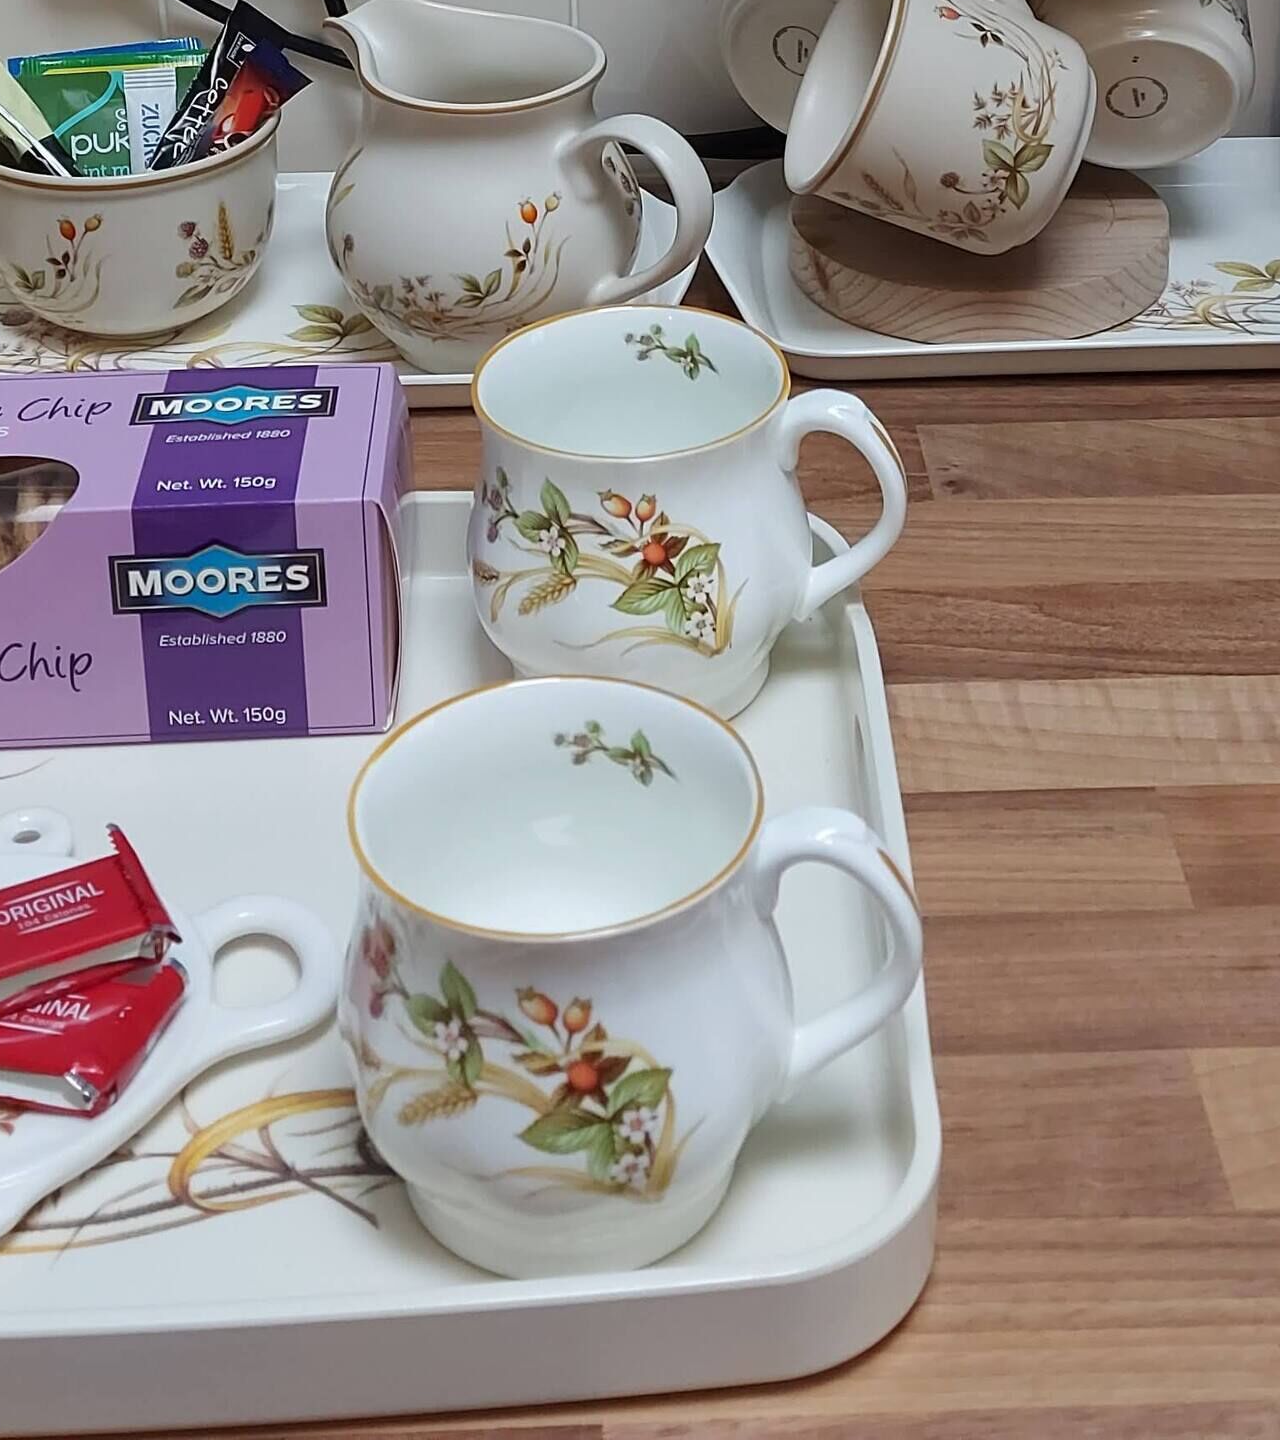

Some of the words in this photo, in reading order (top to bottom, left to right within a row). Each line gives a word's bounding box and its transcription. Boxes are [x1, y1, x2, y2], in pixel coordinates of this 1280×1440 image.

[70, 131, 131, 162] puk
[16, 396, 112, 425] Chip
[148, 393, 324, 417] MOORES
[165, 431, 252, 444] Established
[256, 429, 291, 439] 1880
[156, 479, 193, 491] Net.
[199, 478, 228, 490] Wt.
[233, 476, 277, 490] 150g
[127, 564, 311, 598] MOORES
[158, 632, 247, 647] Established
[251, 630, 287, 644] 1880
[169, 709, 206, 726] Net.
[209, 708, 240, 724] Wt.
[243, 706, 287, 725] 150g
